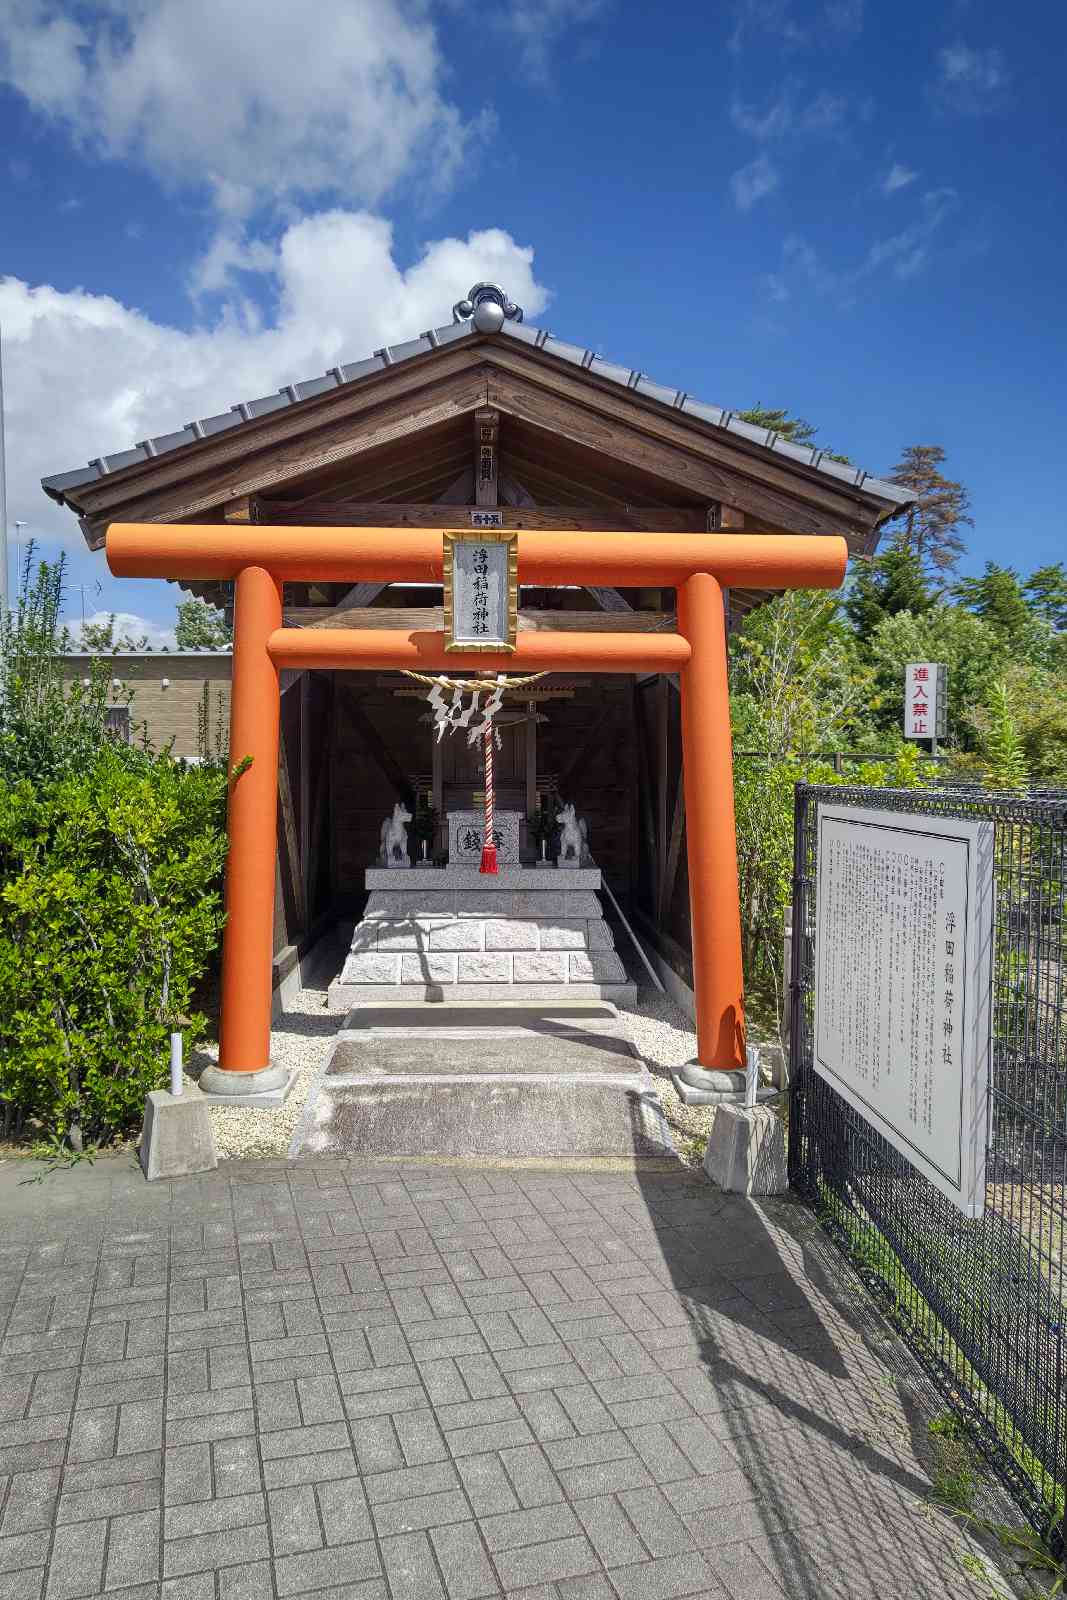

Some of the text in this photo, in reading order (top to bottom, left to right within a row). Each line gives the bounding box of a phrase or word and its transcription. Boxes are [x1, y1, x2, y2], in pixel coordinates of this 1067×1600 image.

[472, 548, 489, 634] 浮田稲荷神社
[912, 667, 929, 734] 進入禁止
[943, 911, 957, 1065] 浮田稲荷神社
